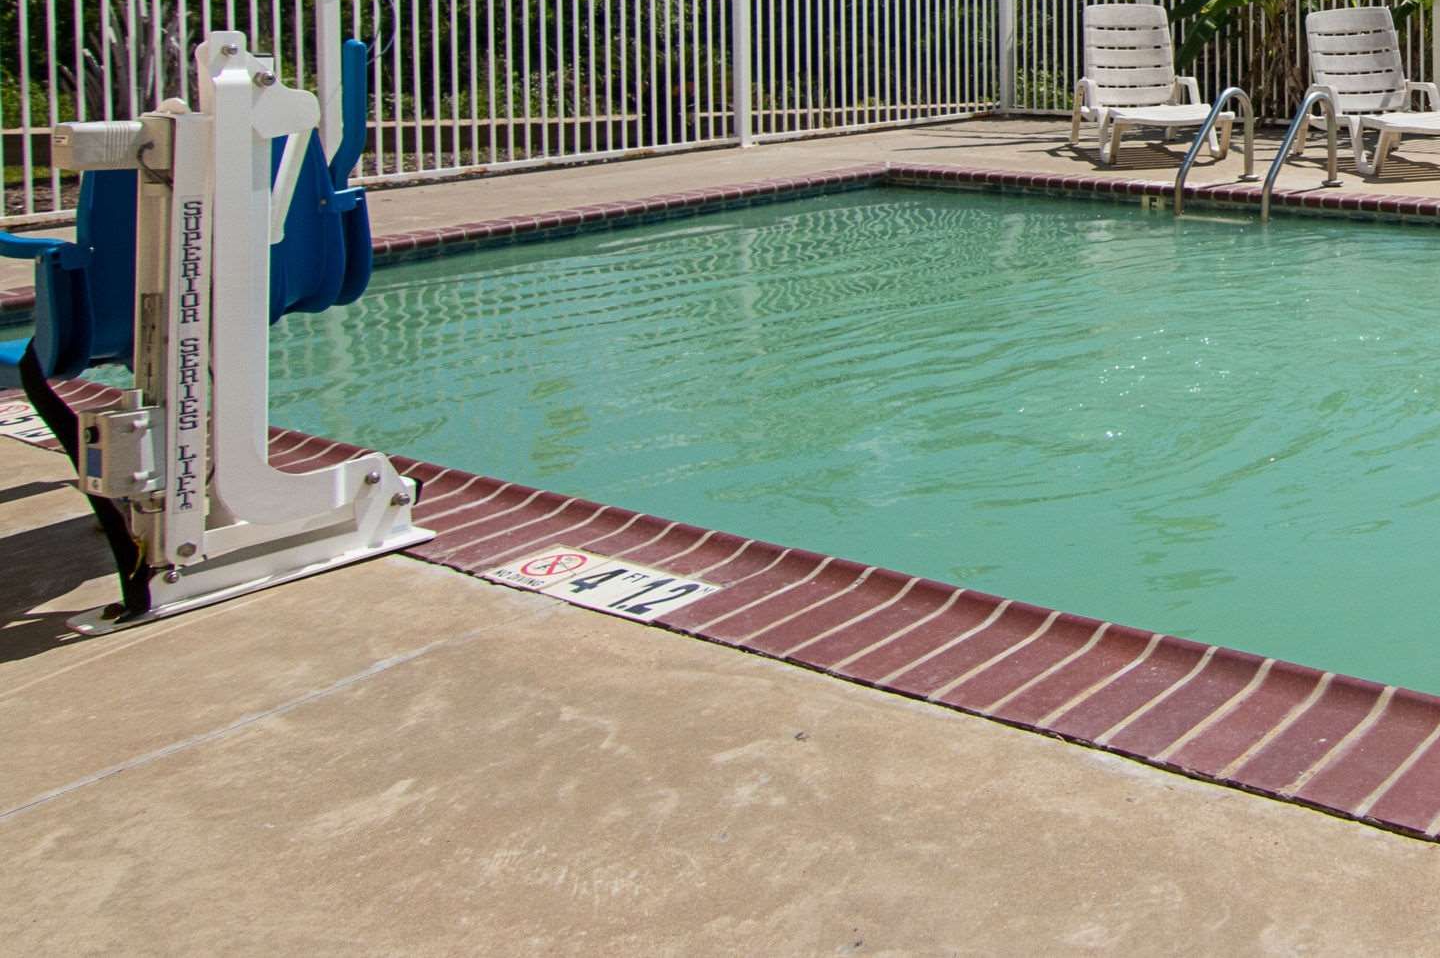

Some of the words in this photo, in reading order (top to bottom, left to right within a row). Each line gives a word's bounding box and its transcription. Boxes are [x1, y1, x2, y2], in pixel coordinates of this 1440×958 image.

[180, 201, 202, 324] SUPERIOR
[178, 337, 200, 431] SERIES
[176, 444, 197, 507] LIFT
[568, 568, 629, 594] 4
[622, 572, 650, 584] FT
